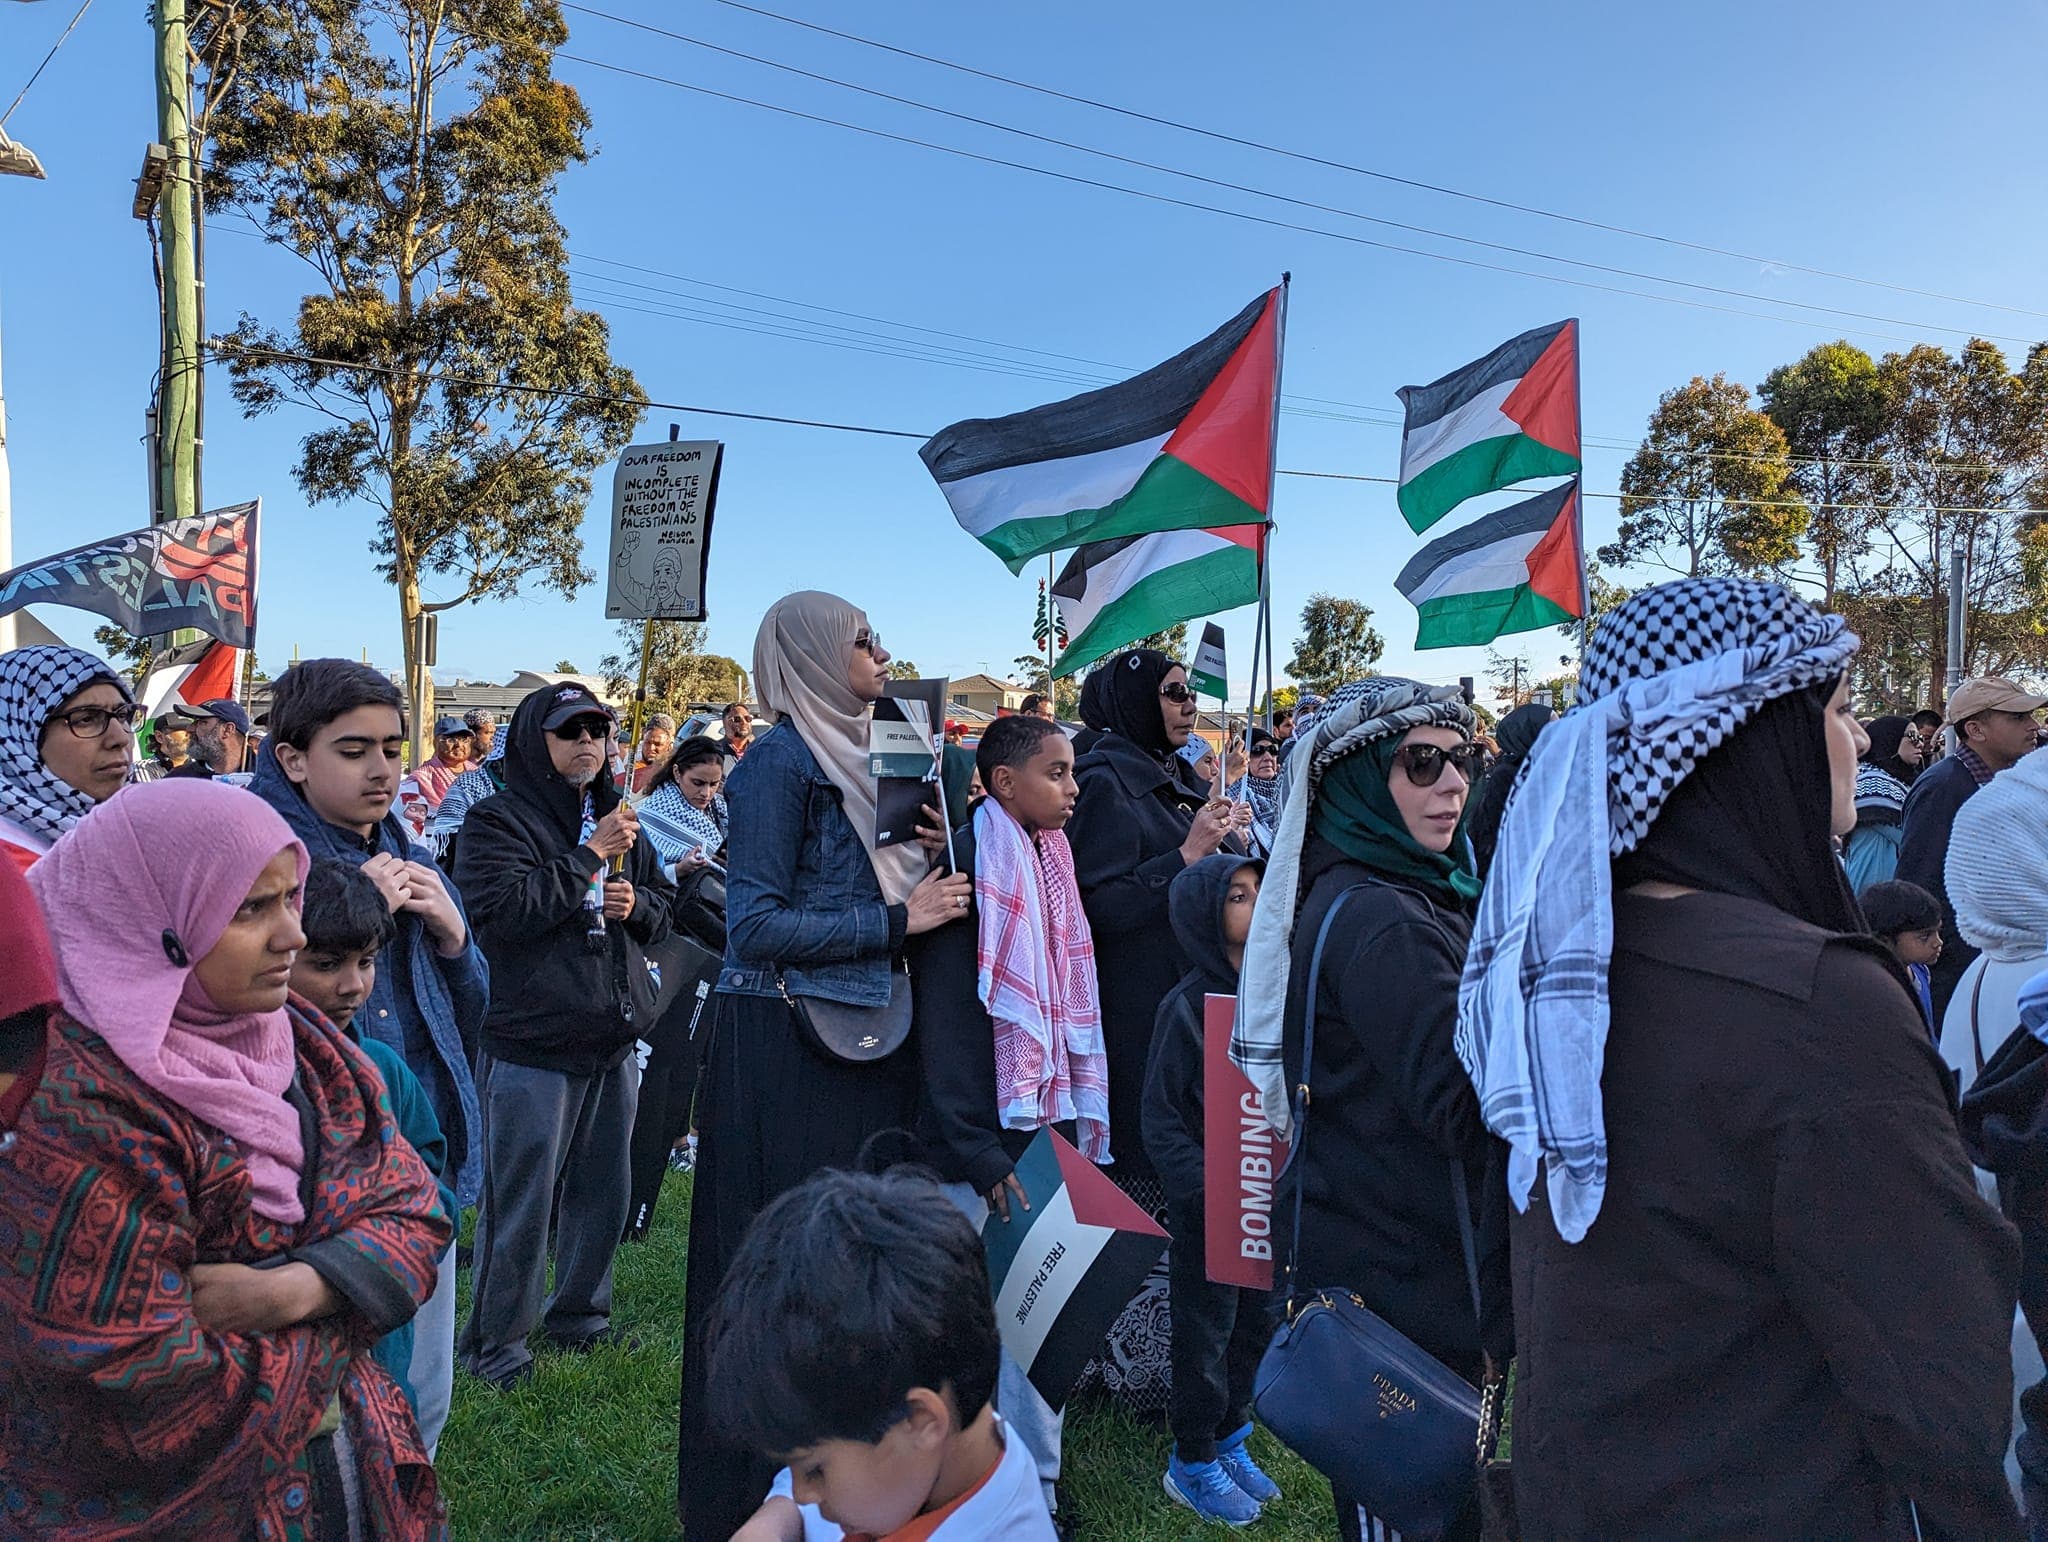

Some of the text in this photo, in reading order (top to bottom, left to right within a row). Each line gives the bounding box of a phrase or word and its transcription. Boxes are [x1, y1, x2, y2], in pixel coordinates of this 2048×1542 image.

[624, 451, 701, 467] OUR FREEDOM
[656, 465, 668, 477] IS
[624, 475, 699, 490] INCOMPLETE
[623, 487, 699, 503] WITHOUT THE
[621, 500, 695, 518] FREEDOM OF
[620, 511, 697, 530] PALESTINIANS
[886, 733, 898, 741] FREE
[1240, 1091, 1273, 1261] BOMBING
[1015, 1241, 1066, 1325] FREE PALESTINE
[1372, 1373, 1416, 1411] PRADA
